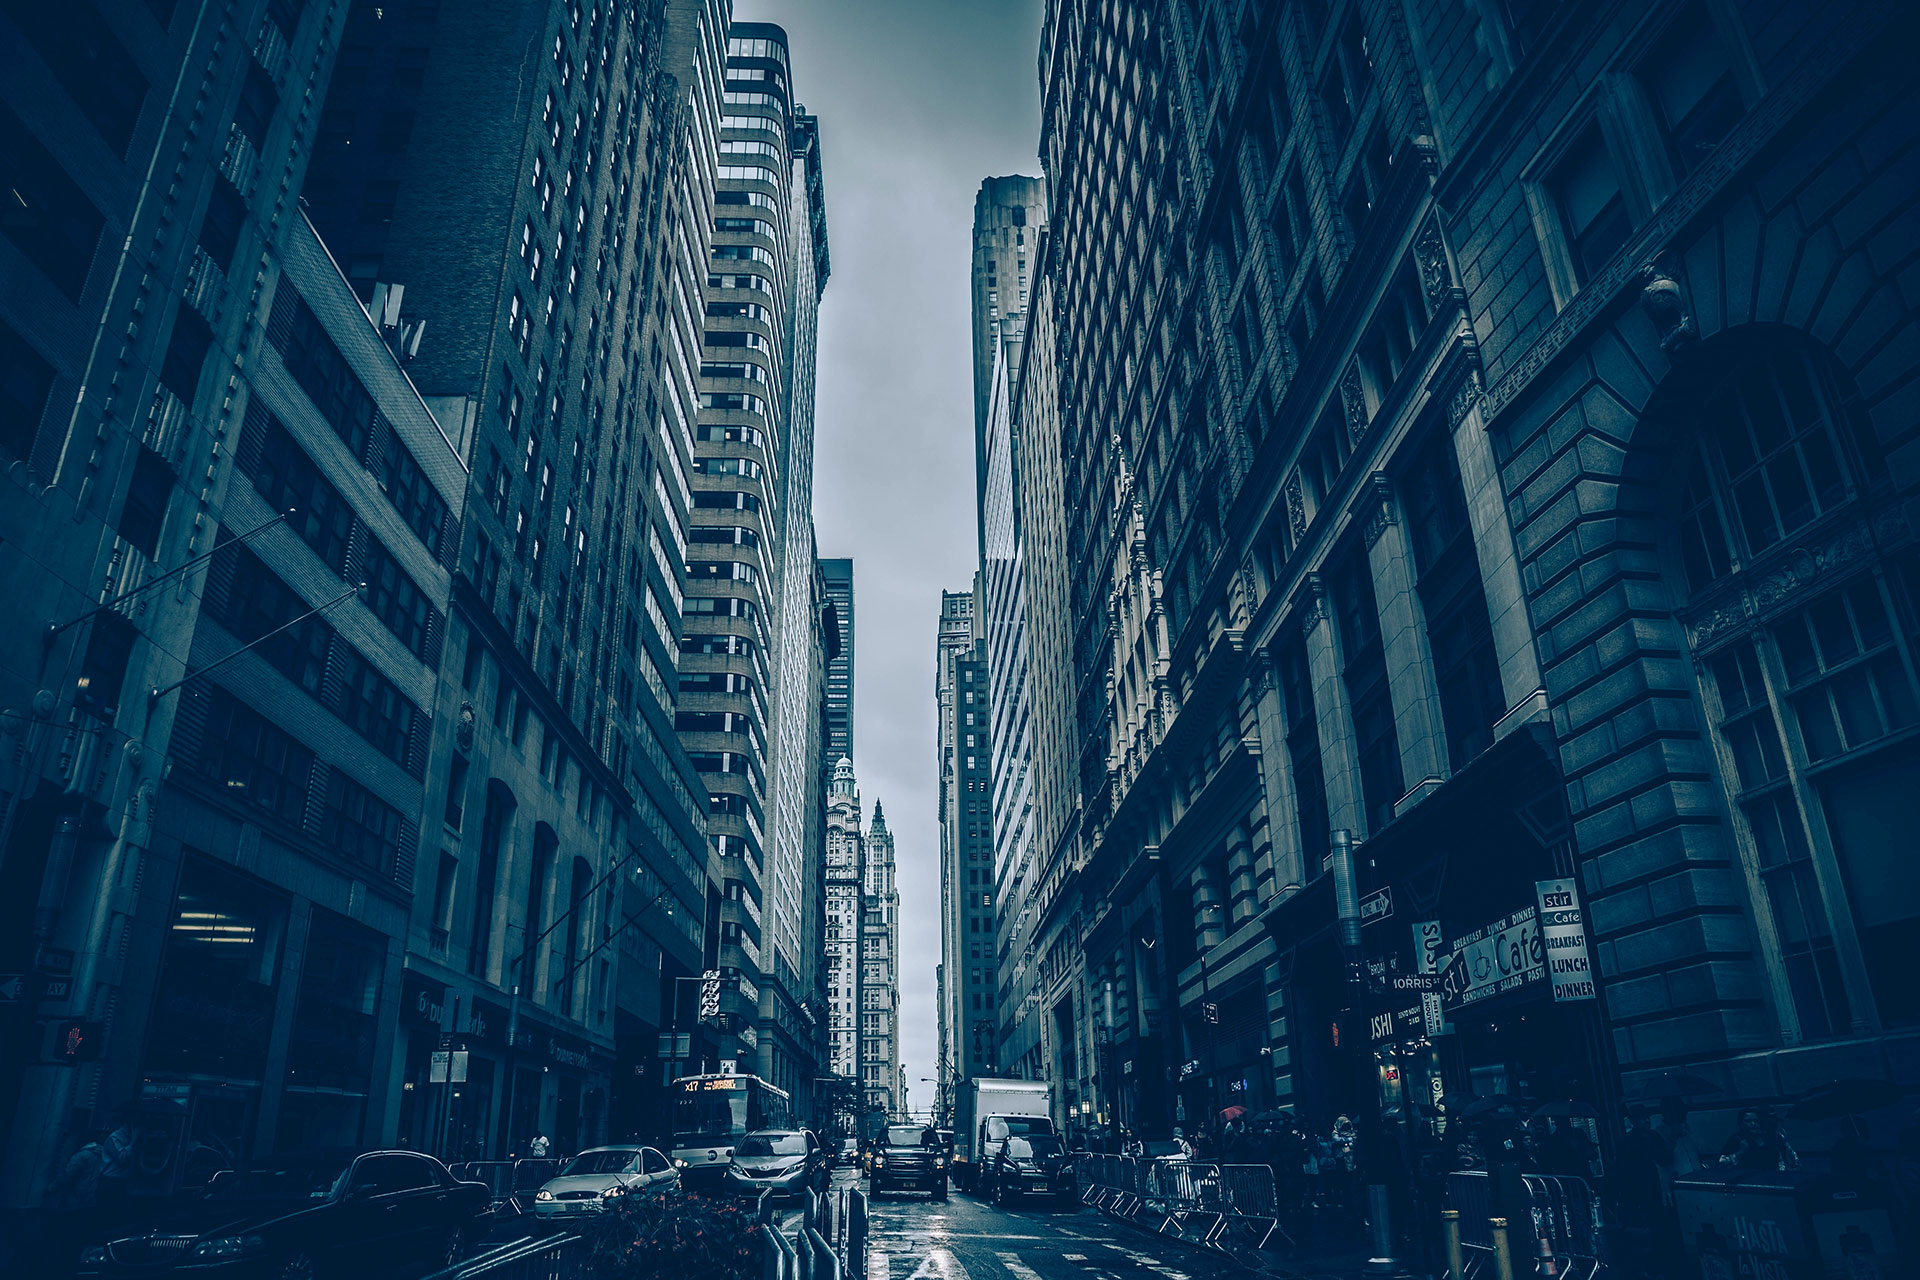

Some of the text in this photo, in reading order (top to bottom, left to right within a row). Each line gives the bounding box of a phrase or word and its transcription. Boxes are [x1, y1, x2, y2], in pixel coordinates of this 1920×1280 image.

[1362, 898, 1387, 917] ONE WAY
[1553, 911, 1580, 924] Café
[1453, 929, 1482, 950] BREAKFAST
[1487, 918, 1507, 936] LUNCH
[1546, 934, 1585, 950] BREAKFAST
[1496, 926, 1543, 976] Café
[1552, 957, 1589, 974] LUNCH
[48, 983, 66, 995] AY
[1462, 984, 1496, 1004] SANDWICHES
[1500, 974, 1523, 992] SALADS
[1555, 981, 1595, 999] DINNER
[1371, 1013, 1393, 1040] USHI
[1424, 1001, 1434, 1034] NOUVEAU
